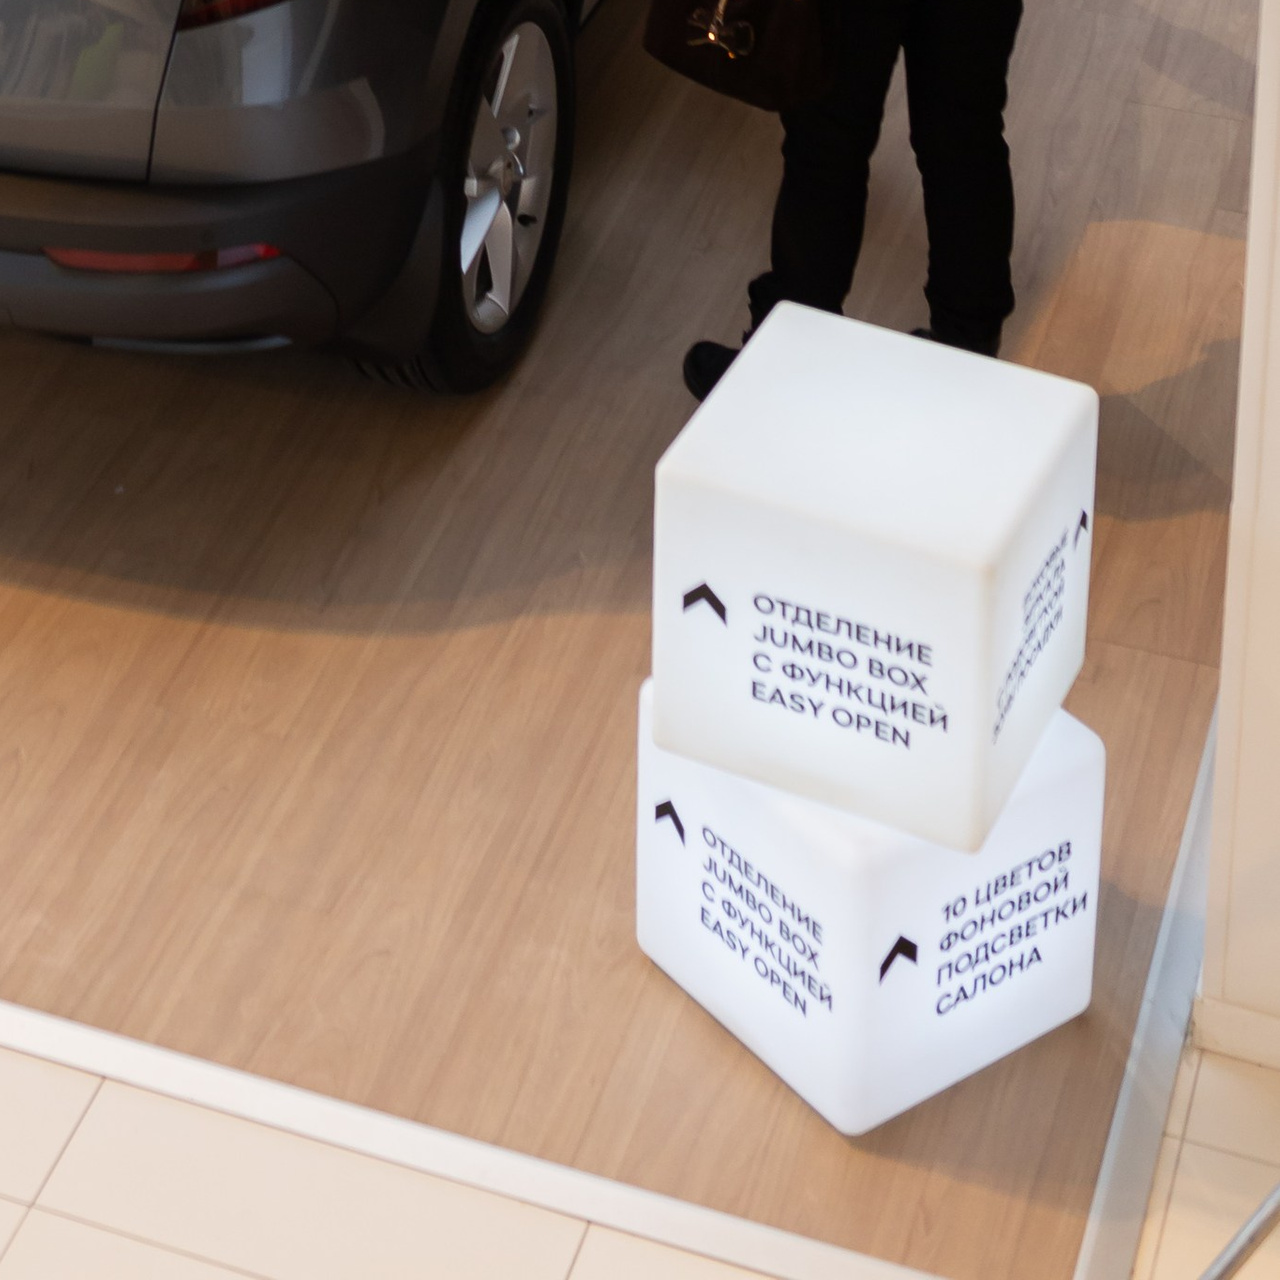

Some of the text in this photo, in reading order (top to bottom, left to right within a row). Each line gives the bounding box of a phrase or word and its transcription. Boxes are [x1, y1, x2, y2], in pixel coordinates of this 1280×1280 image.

[753, 594, 933, 667] ОТДЕЛЕНИЕ
[753, 624, 928, 694] JUMBO BOX
[751, 681, 911, 749] EASY OPEN
[752, 653, 949, 733] С ФУНКЦИЕЙ
[702, 826, 823, 943] ОТДЕЛЕНИЕ
[703, 856, 820, 970] JUMBO BOX
[939, 865, 1070, 952] ФОНОВОЙ
[942, 841, 1072, 922] 10 ЦВЕТОВ
[700, 906, 807, 1017] EASY OPEN
[701, 881, 833, 1012] С ФУНКЦИЕЙ
[937, 892, 1089, 986] ПОДСВЕТКИ
[936, 946, 1043, 1017] САЛОНА
